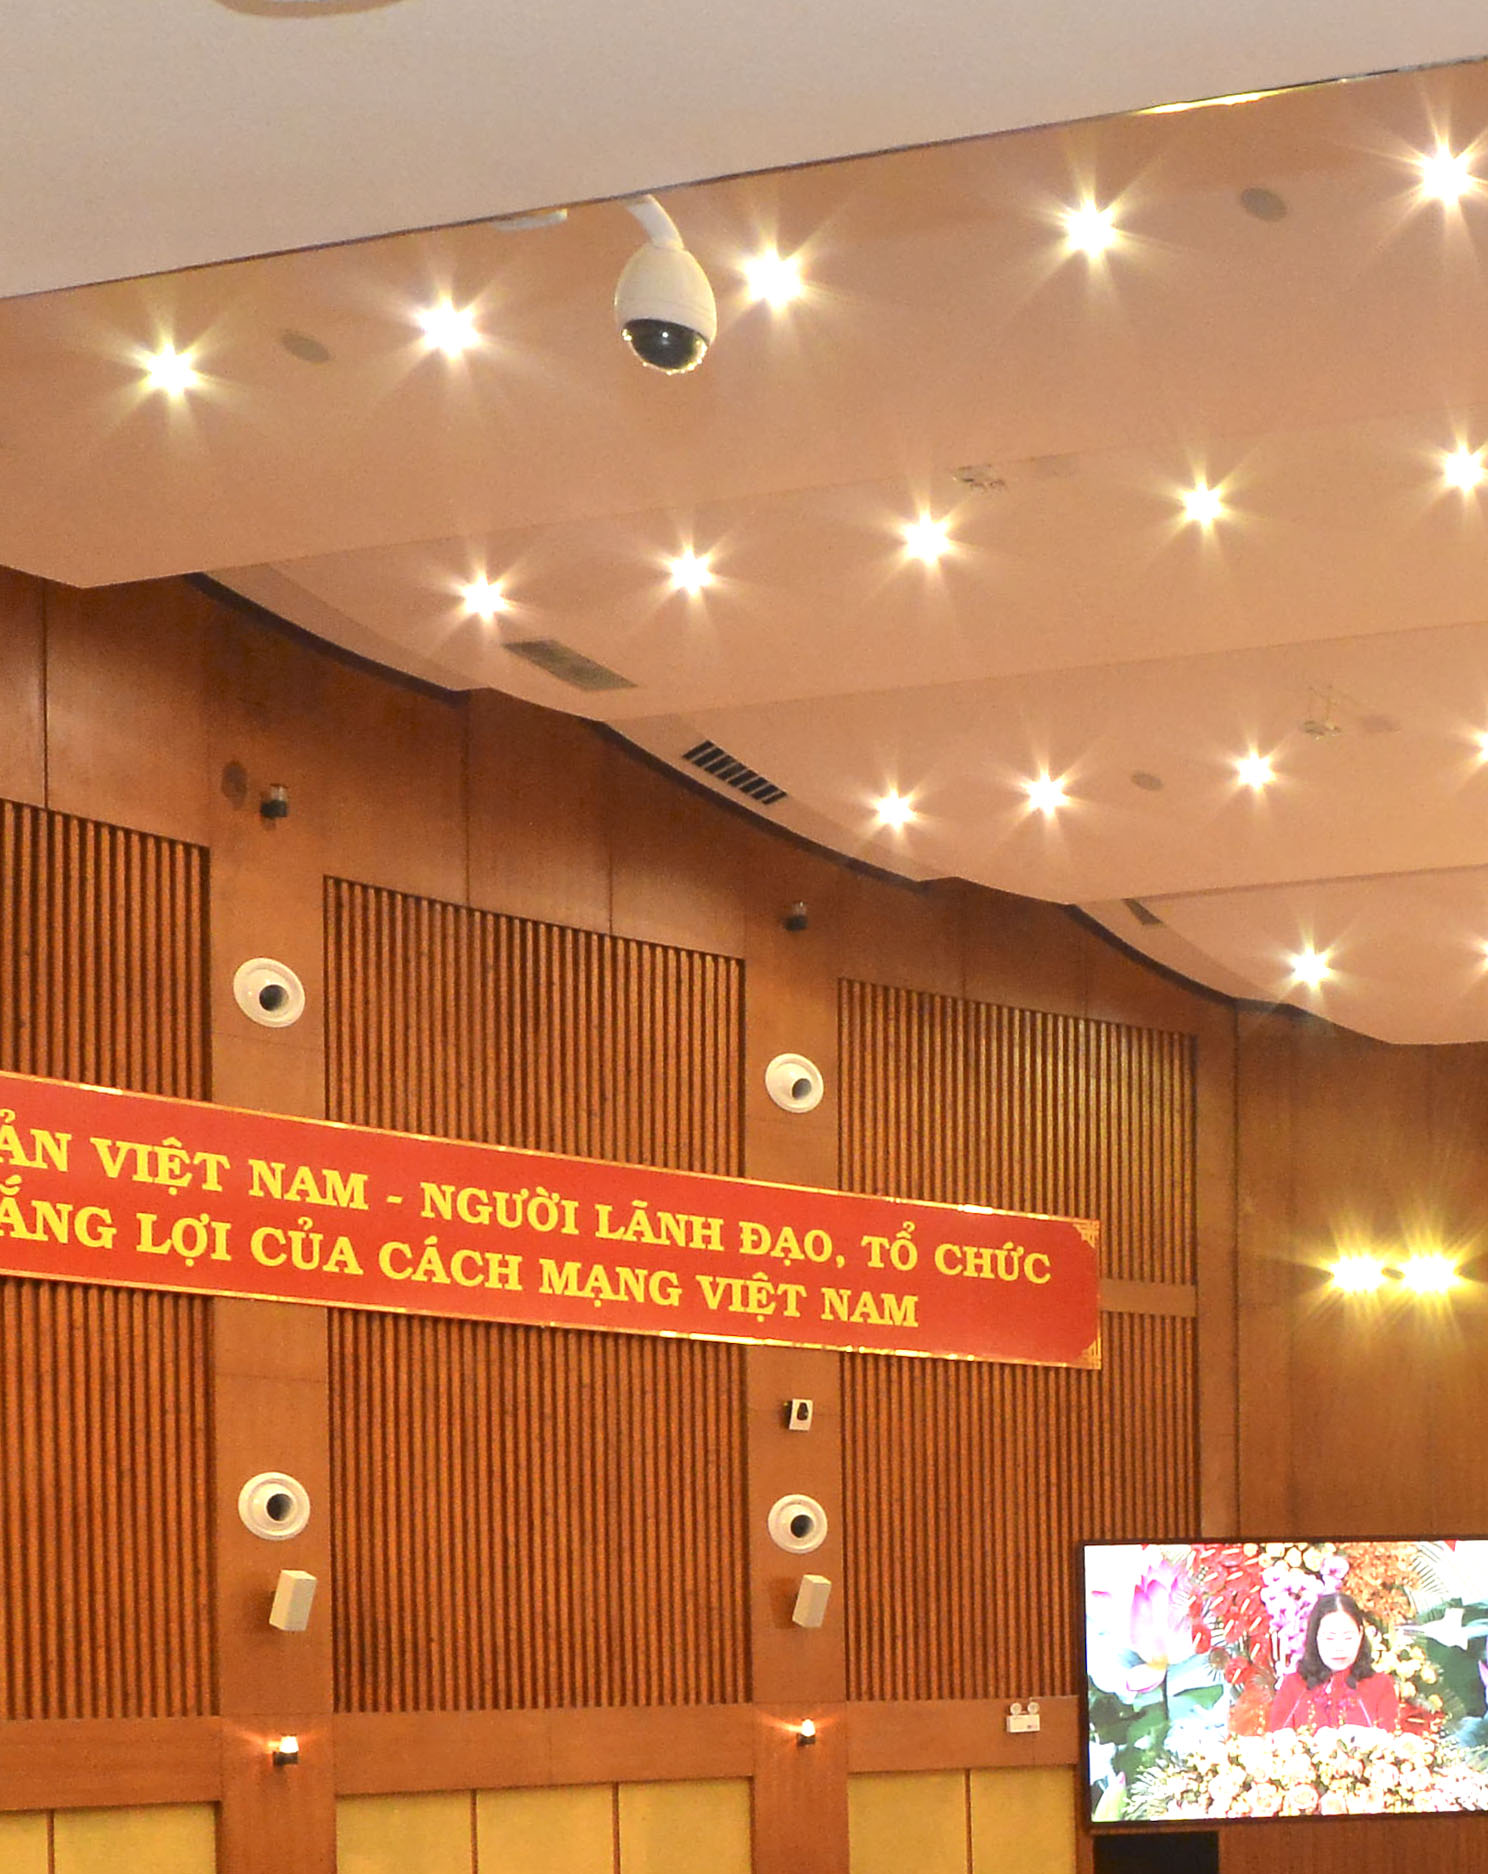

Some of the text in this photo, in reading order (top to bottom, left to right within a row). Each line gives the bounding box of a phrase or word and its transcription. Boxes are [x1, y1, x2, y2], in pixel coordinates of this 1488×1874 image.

[91, 1138, 231, 1196] VIỆT
[250, 1160, 369, 1220] NAM
[422, 1184, 580, 1235] NGƯỜI
[596, 1201, 725, 1252] LÃNH
[740, 1223, 845, 1281] ĐẠO,
[862, 1223, 918, 1271] TỔ
[936, 1243, 1051, 1284] CHỨC
[138, 1214, 232, 1267] LỢI
[252, 1218, 364, 1276] CỦA
[380, 1237, 523, 1291] CÁCH
[540, 1260, 683, 1308] MẠNG
[697, 1263, 807, 1323] VIỆT
[822, 1289, 919, 1328] NAM
